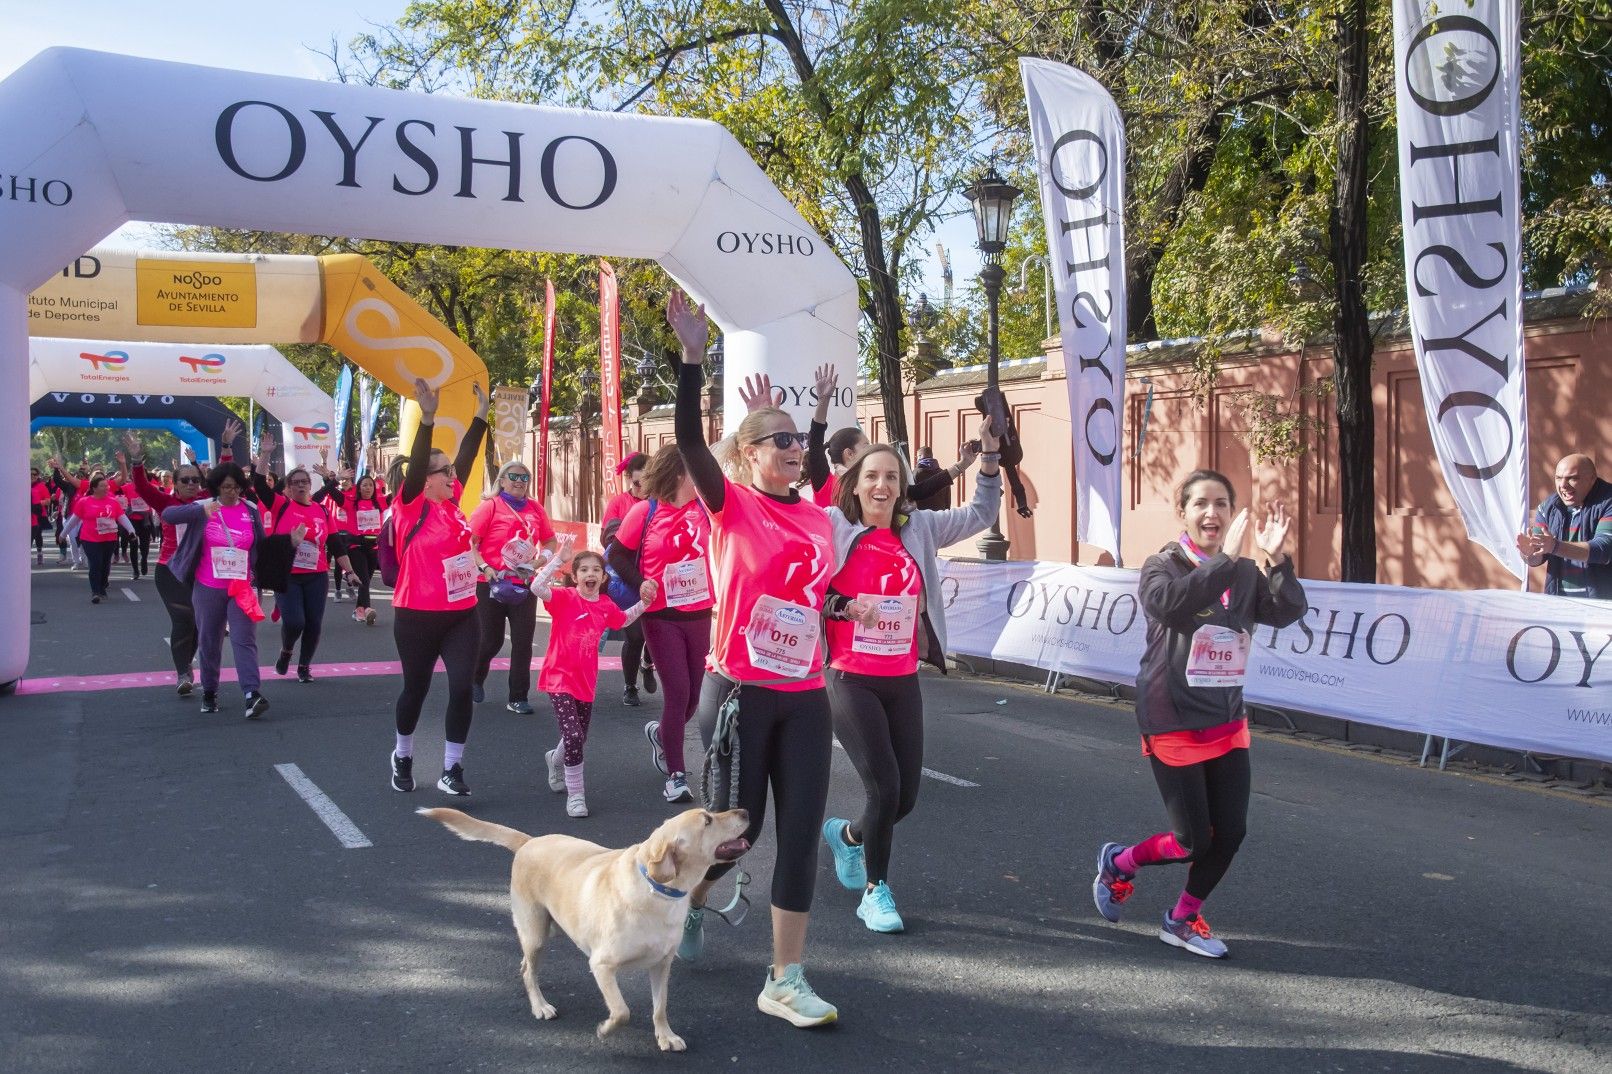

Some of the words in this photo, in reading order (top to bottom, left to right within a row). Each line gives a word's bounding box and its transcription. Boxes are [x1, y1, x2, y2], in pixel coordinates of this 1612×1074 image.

[215, 100, 618, 210] OYSHO
[717, 231, 814, 257] OYSHO
[157, 289, 239, 302] AYUNTAMIENTO
[60, 297, 118, 312] Municipal
[169, 303, 183, 312] DE
[186, 302, 226, 313] SEVILLA
[45, 310, 101, 322] Deportes
[80, 373, 130, 382] TotalEnergies
[180, 376, 227, 384] TotalEnergies
[51, 392, 175, 405] VOLVO
[460, 570, 472, 581] 016
[680, 578, 698, 588] 016
[1007, 580, 1138, 635] OYSHO
[877, 620, 901, 631] 016
[771, 630, 799, 647] 016
[775, 647, 786, 655] 775
[1208, 650, 1233, 661] 016
[1506, 625, 1612, 688] OY
[1259, 664, 1345, 688] WWW.OYSHO.COM
